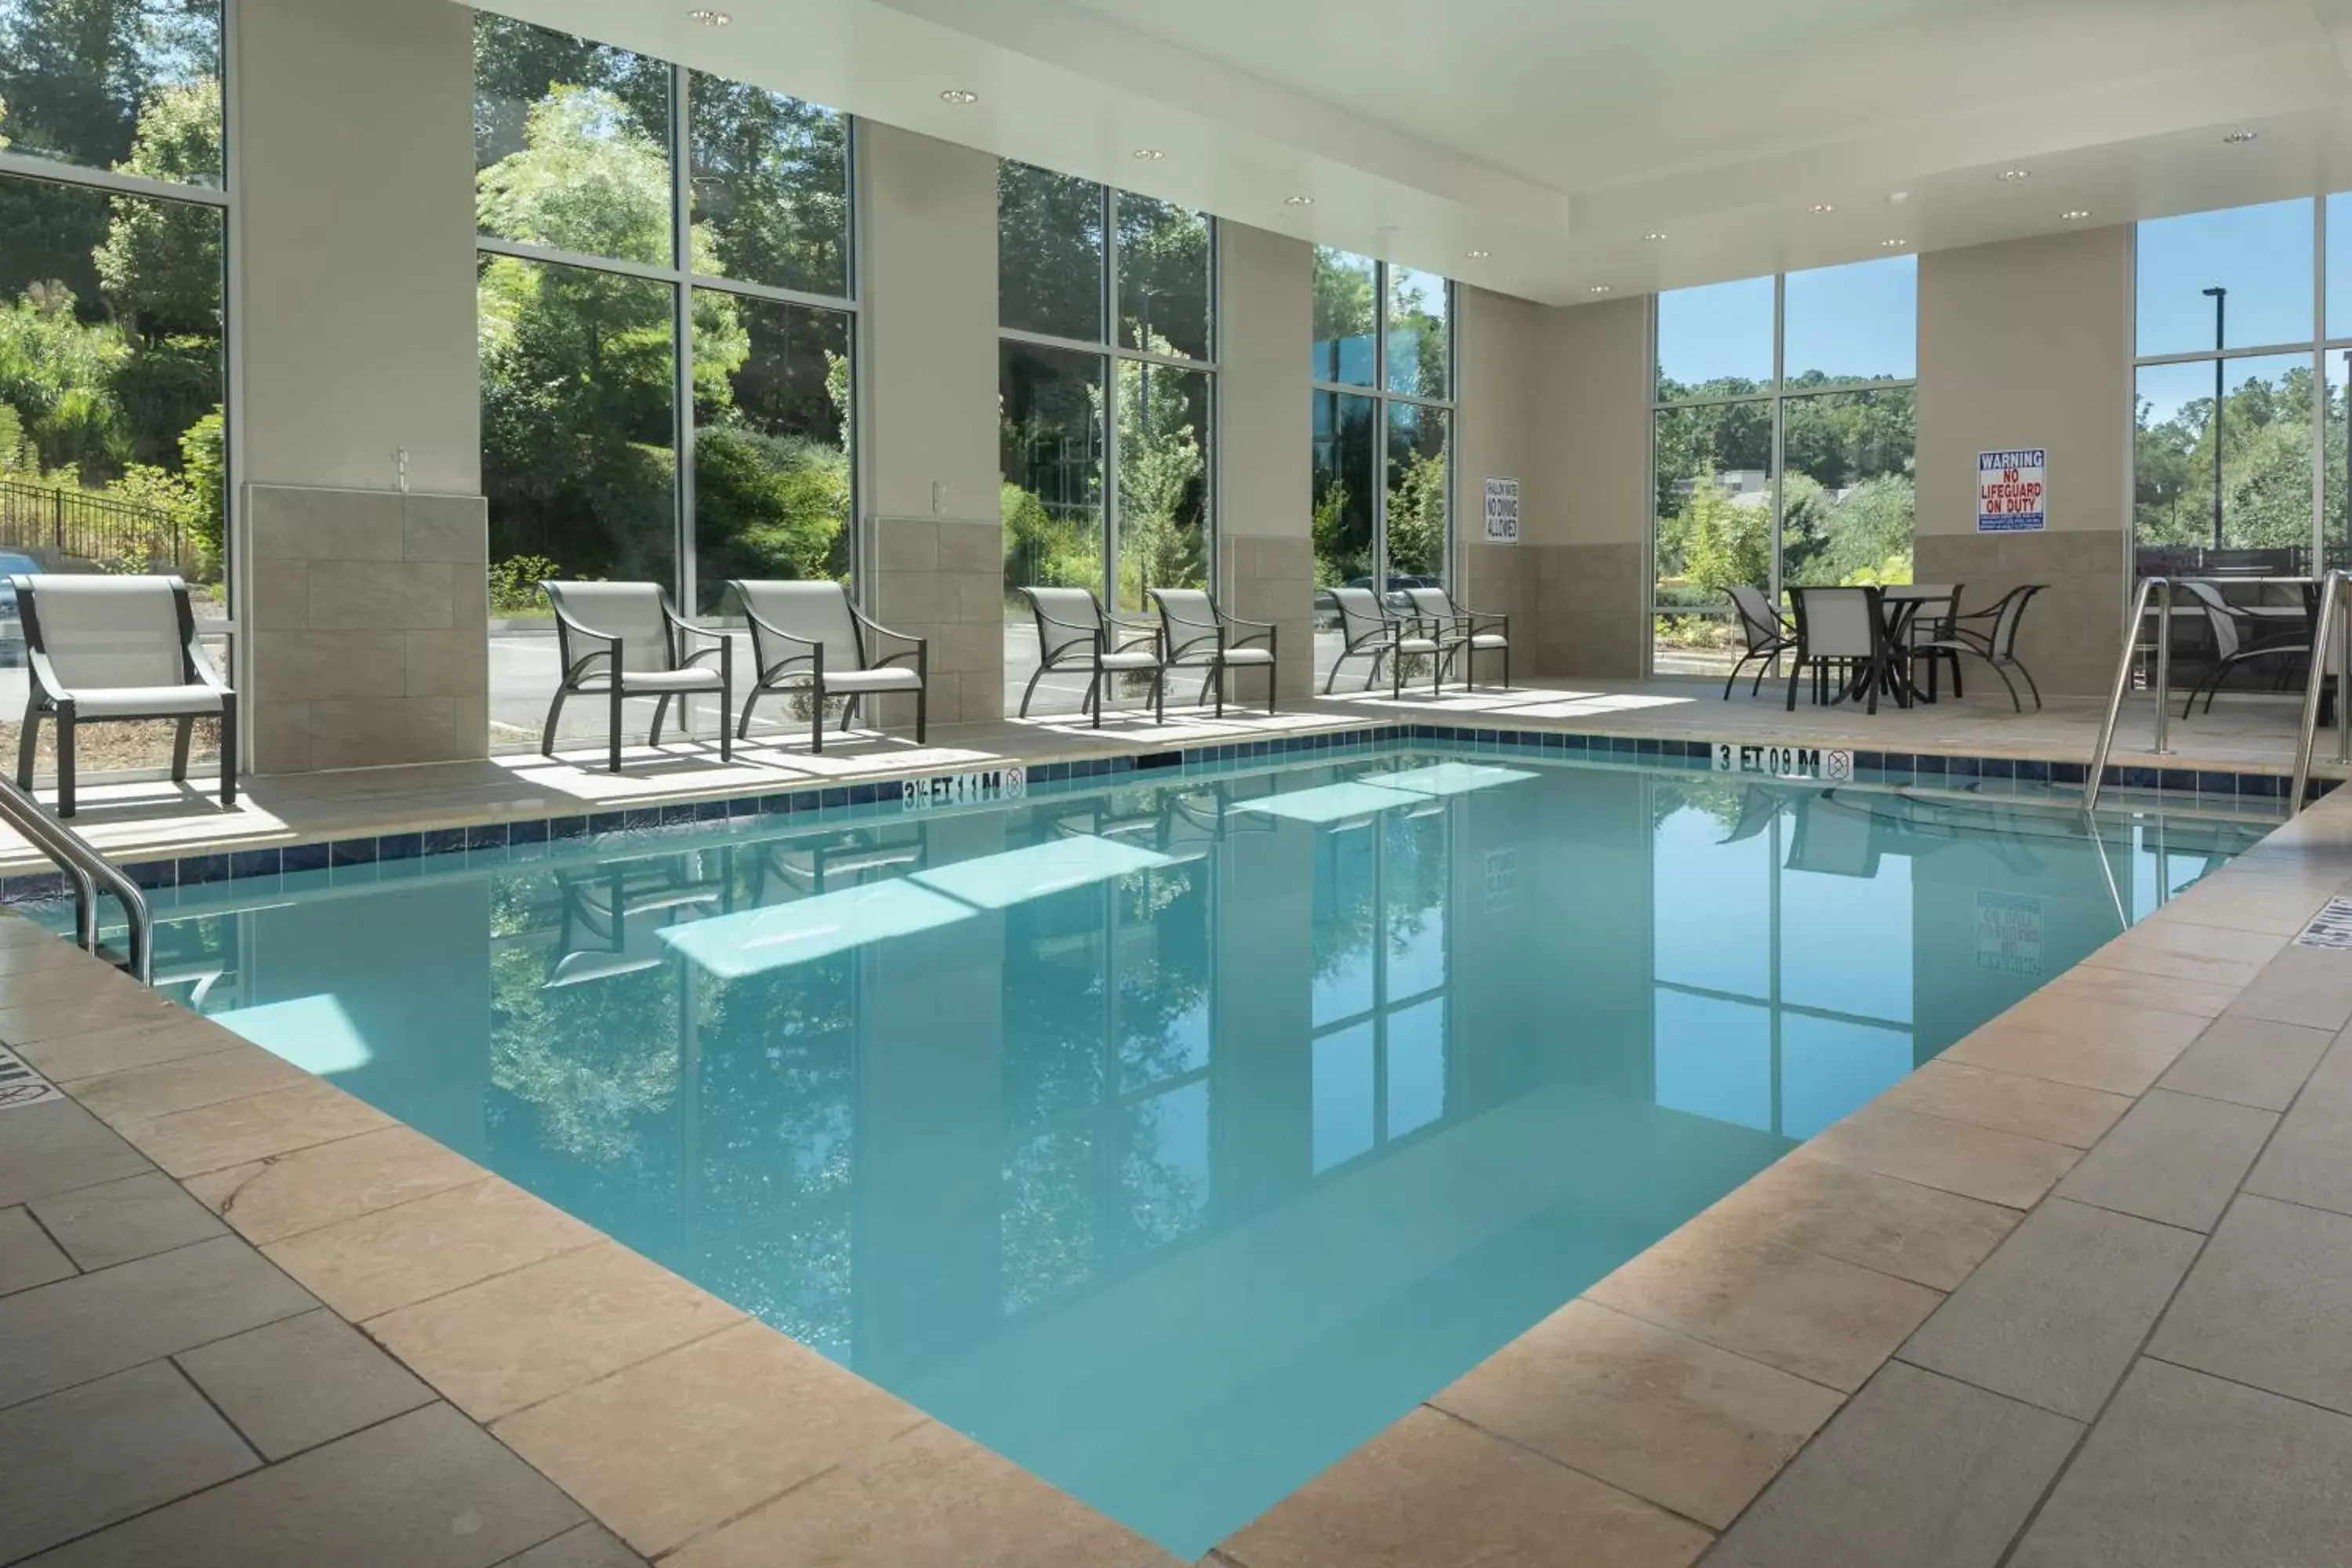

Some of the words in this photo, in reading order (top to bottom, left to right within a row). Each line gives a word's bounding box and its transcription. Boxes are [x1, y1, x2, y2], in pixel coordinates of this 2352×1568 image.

[1981, 452, 2042, 469] WARNING
[2003, 469, 2019, 483] NO
[1981, 482, 2042, 499] LIFEGUARD
[1488, 498, 1496, 516] NO
[1987, 499, 2002, 513] ON
[2007, 498, 2036, 513] DUTY
[1488, 517, 1517, 537] ALLOWED
[1719, 745, 1731, 769] 3
[1798, 749, 1820, 775] M
[931, 775, 953, 803] FT
[982, 771, 1001, 798] M
